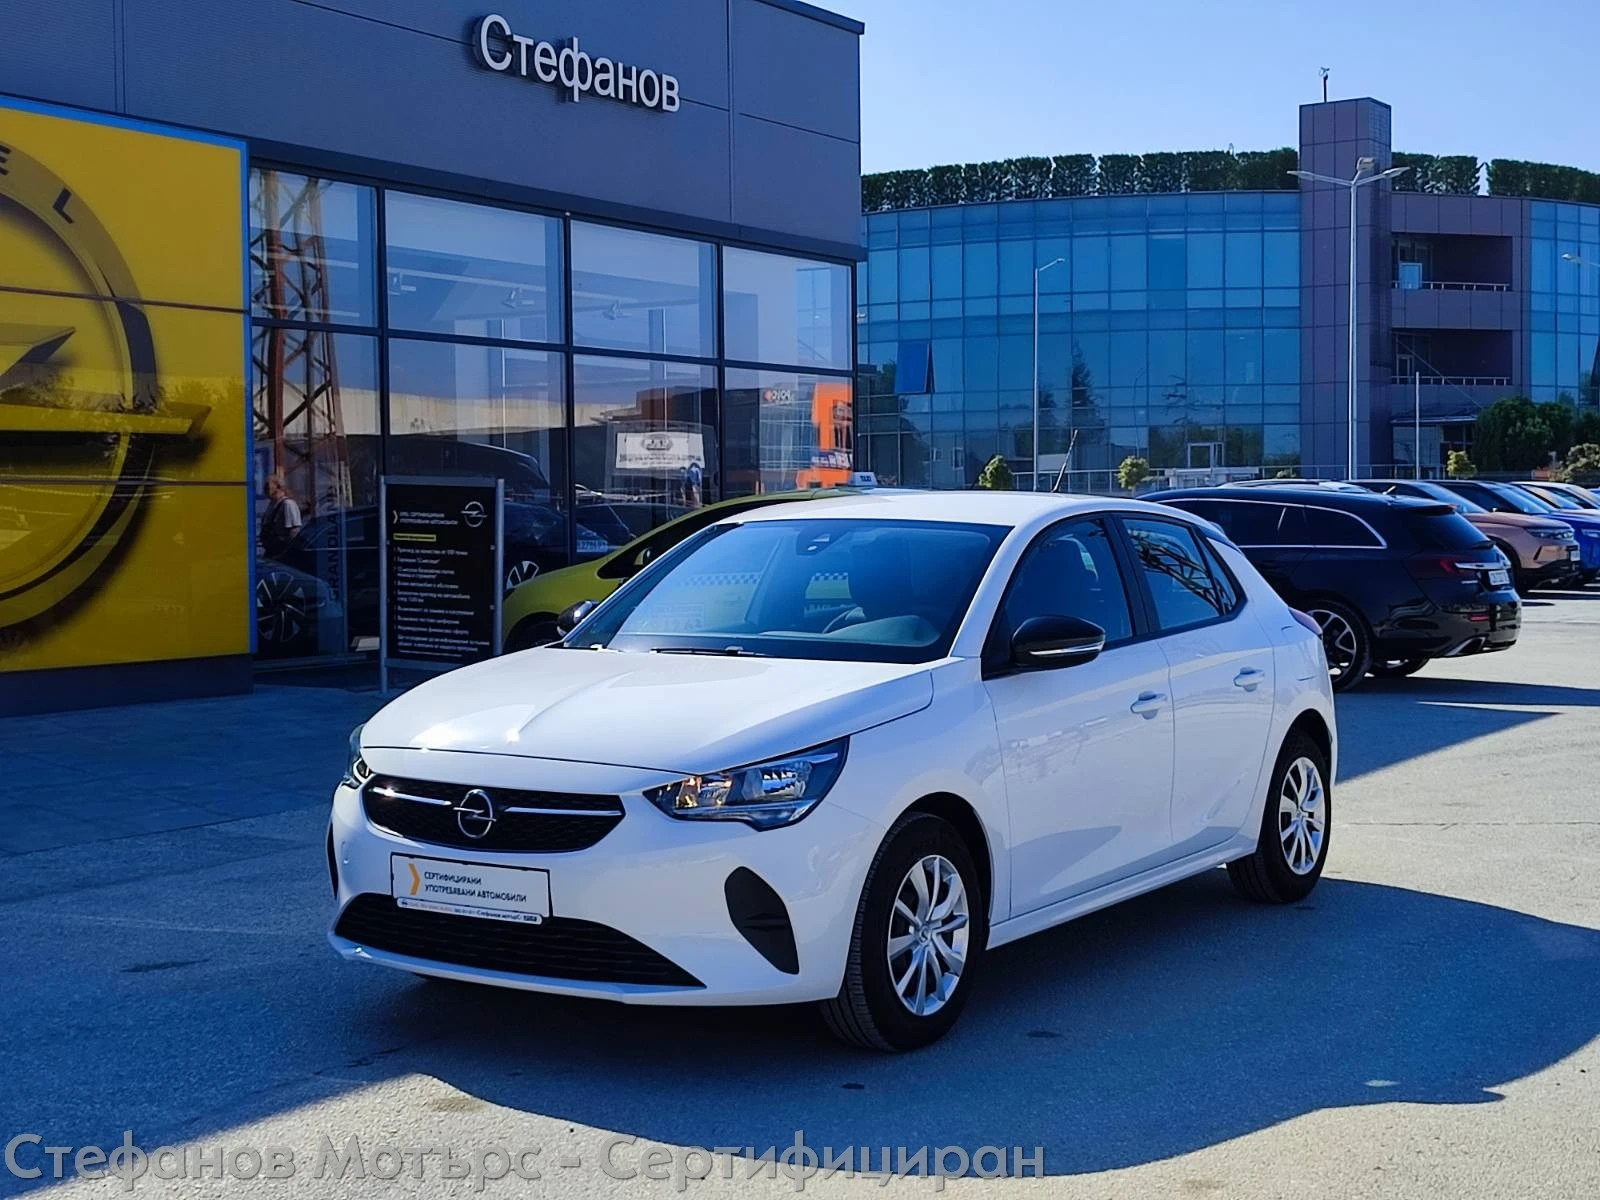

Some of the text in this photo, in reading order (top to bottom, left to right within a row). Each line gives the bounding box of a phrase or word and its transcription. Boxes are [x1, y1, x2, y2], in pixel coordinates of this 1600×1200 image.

[478, 14, 680, 112] Стефанов
[424, 871, 482, 885] СЕРТИФИЦИРАНИ
[424, 884, 527, 902] УПОТРЕБЯВАНИ АВТОМОБИЛИ
